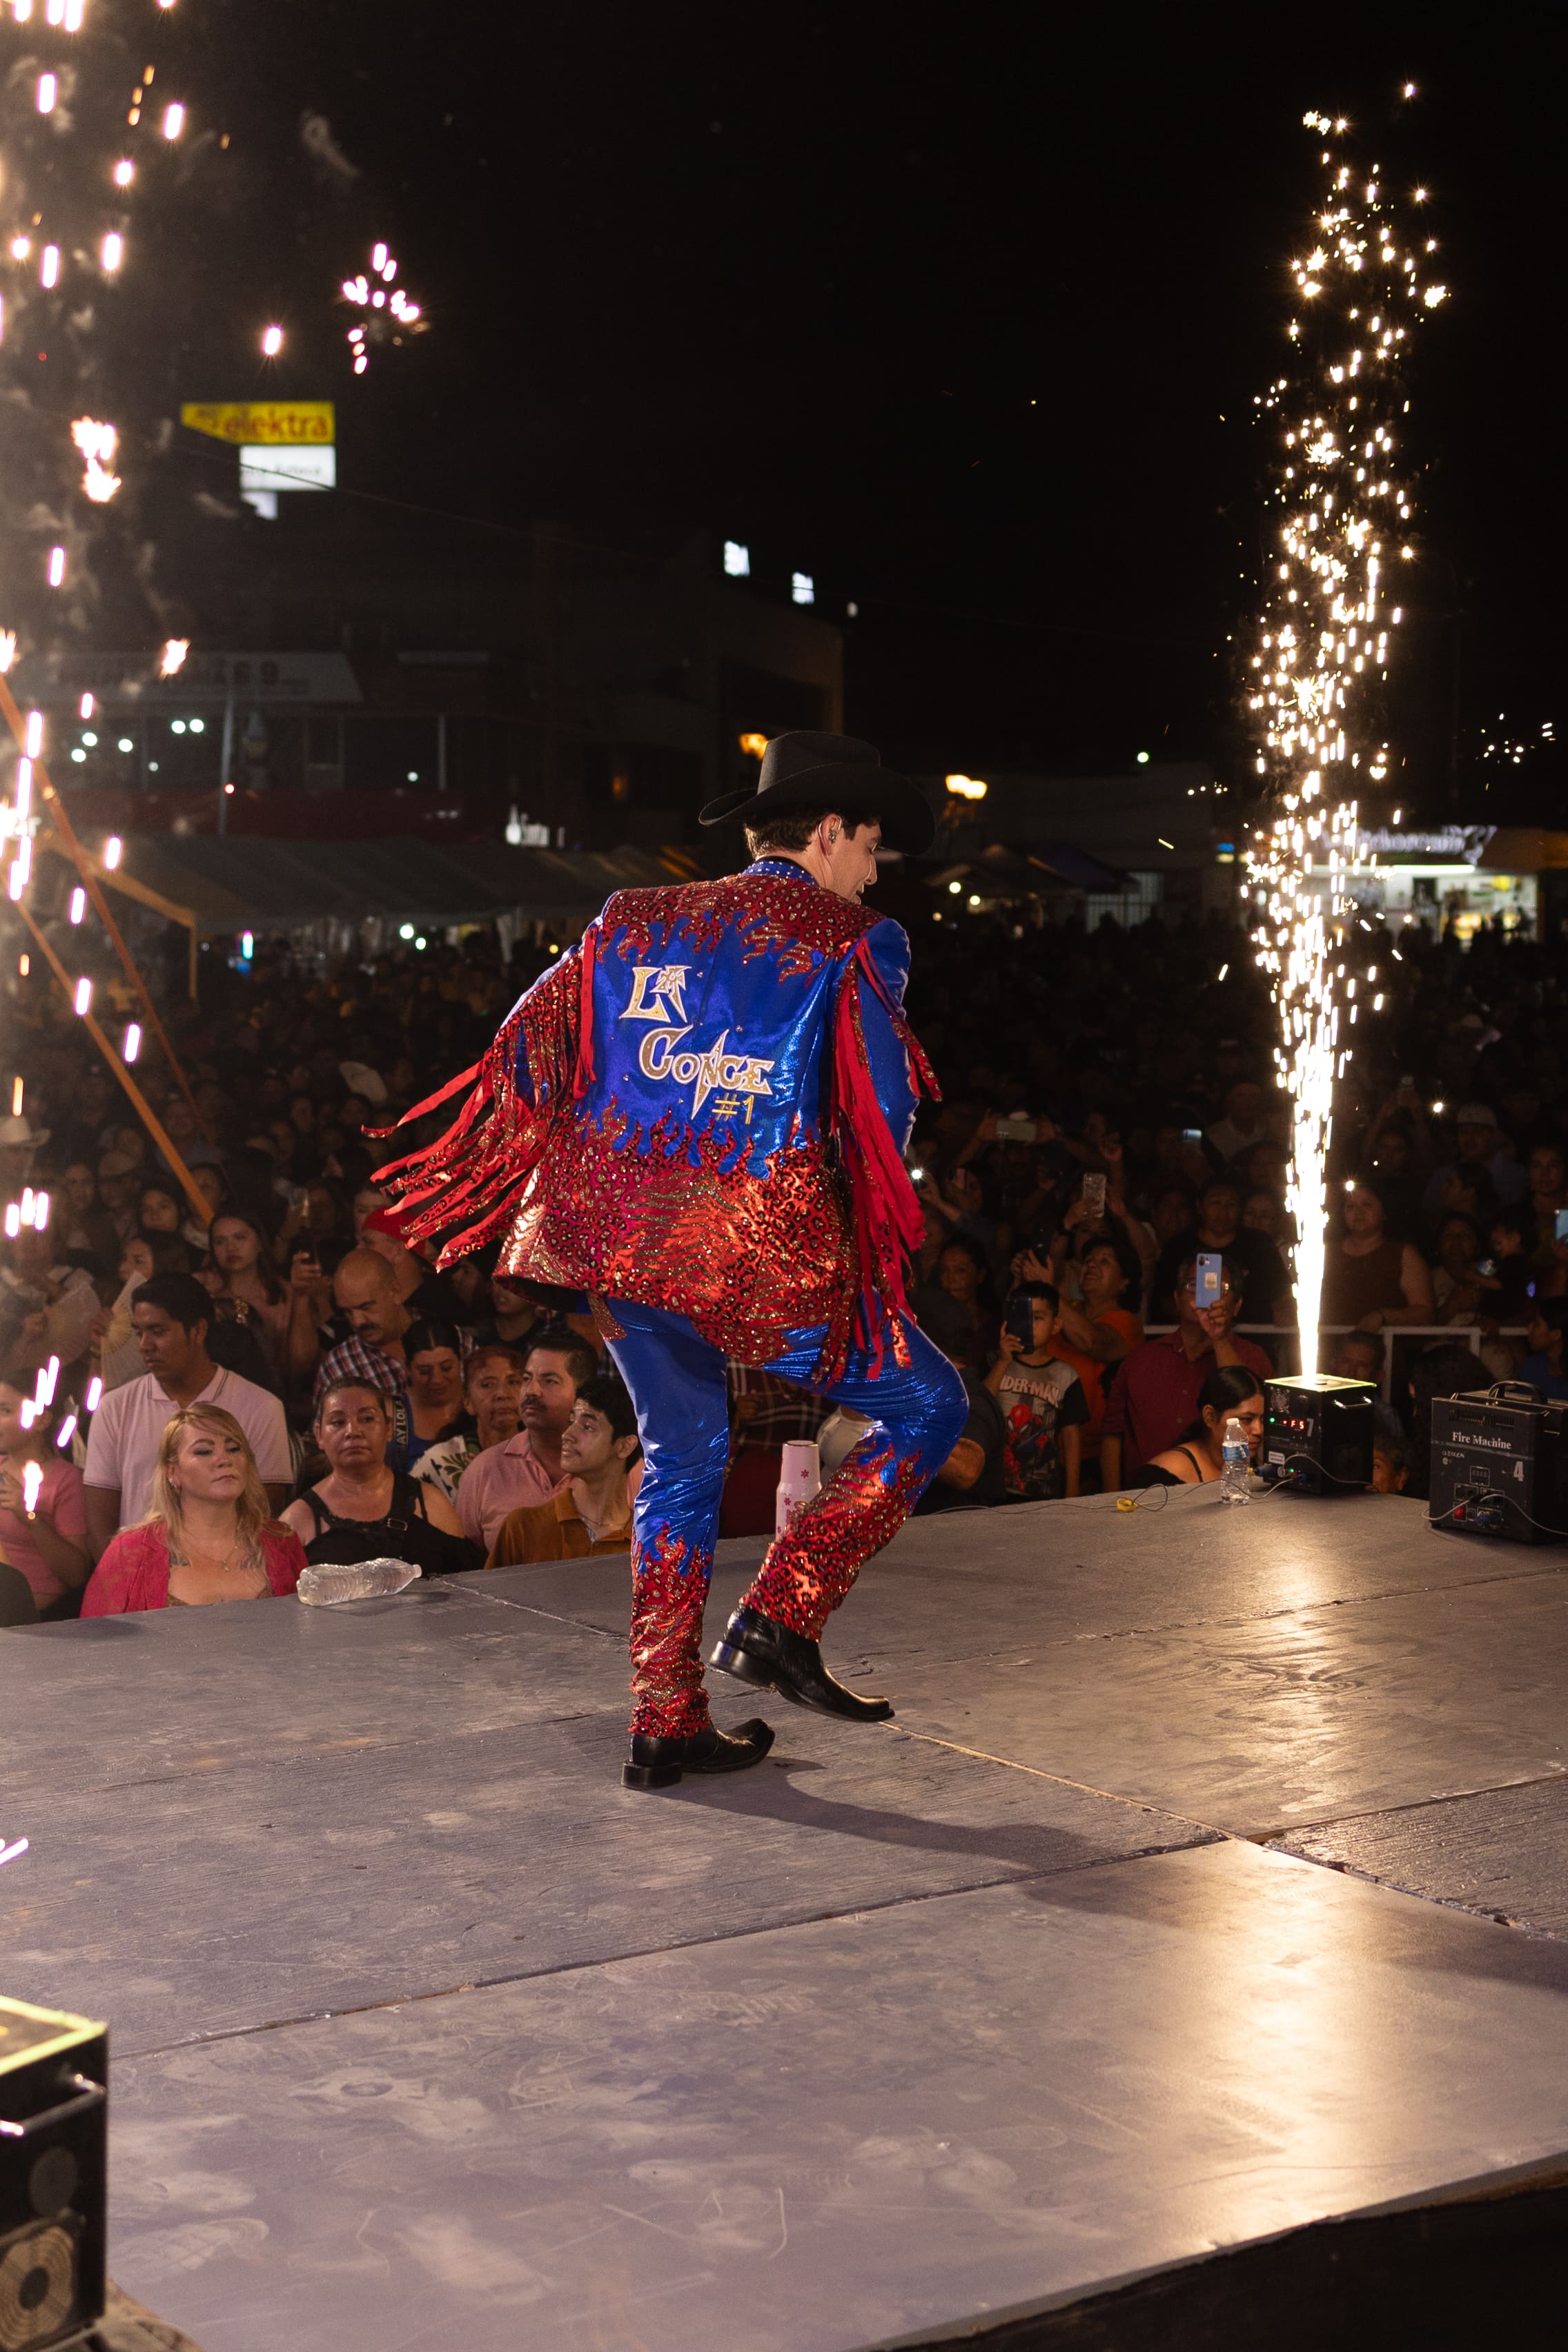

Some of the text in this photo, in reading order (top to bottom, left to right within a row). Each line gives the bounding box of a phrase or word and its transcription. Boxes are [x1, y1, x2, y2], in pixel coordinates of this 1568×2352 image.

[619, 966, 692, 1023] LA
[712, 1092, 754, 1125] #1
[999, 1374, 1060, 1409] IDER-MAN
[1306, 1418, 1314, 1437] 7
[1452, 1431, 1471, 1444] Fire
[1472, 1434, 1512, 1449] Machine
[1513, 1460, 1524, 1482] 4
